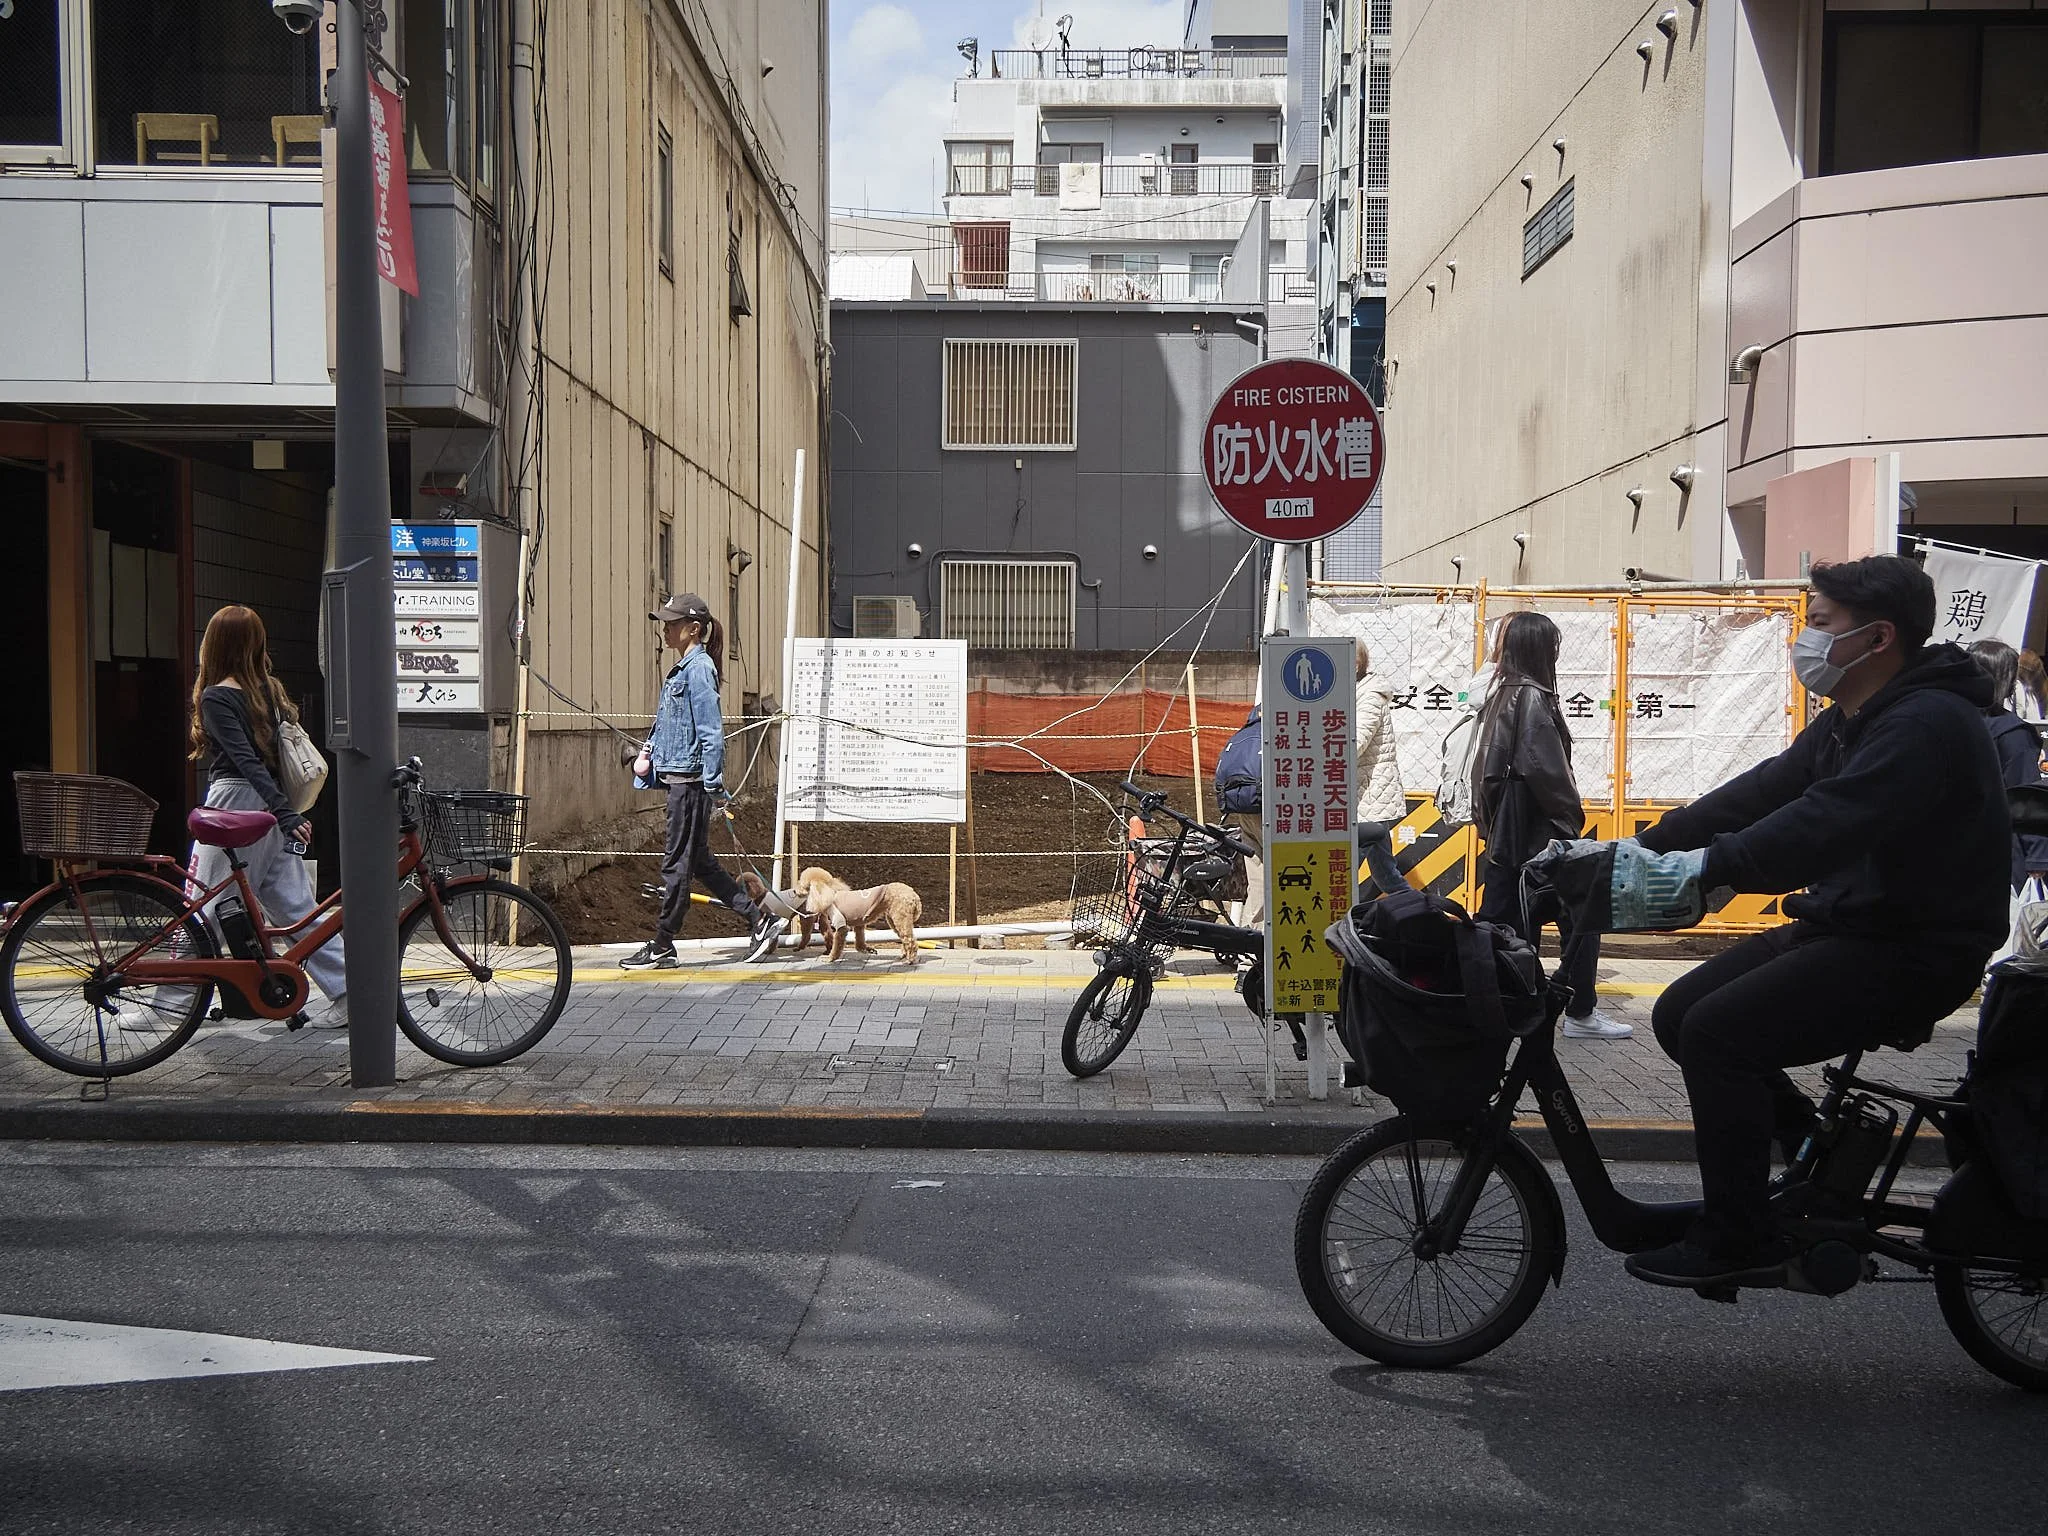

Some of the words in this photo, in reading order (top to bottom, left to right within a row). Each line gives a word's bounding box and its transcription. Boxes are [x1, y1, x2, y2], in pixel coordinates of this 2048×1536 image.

[1234, 388, 1271, 407] FIRE
[1277, 385, 1350, 405] CISTERN
[1213, 416, 1374, 486] 防火水槽
[421, 537, 469, 547] 神楽坂ビル
[393, 594, 475, 606] r.TRAINING
[398, 651, 460, 674] BRONX
[1565, 692, 1595, 718] 全
[1322, 708, 1348, 832] 歩行者天国
